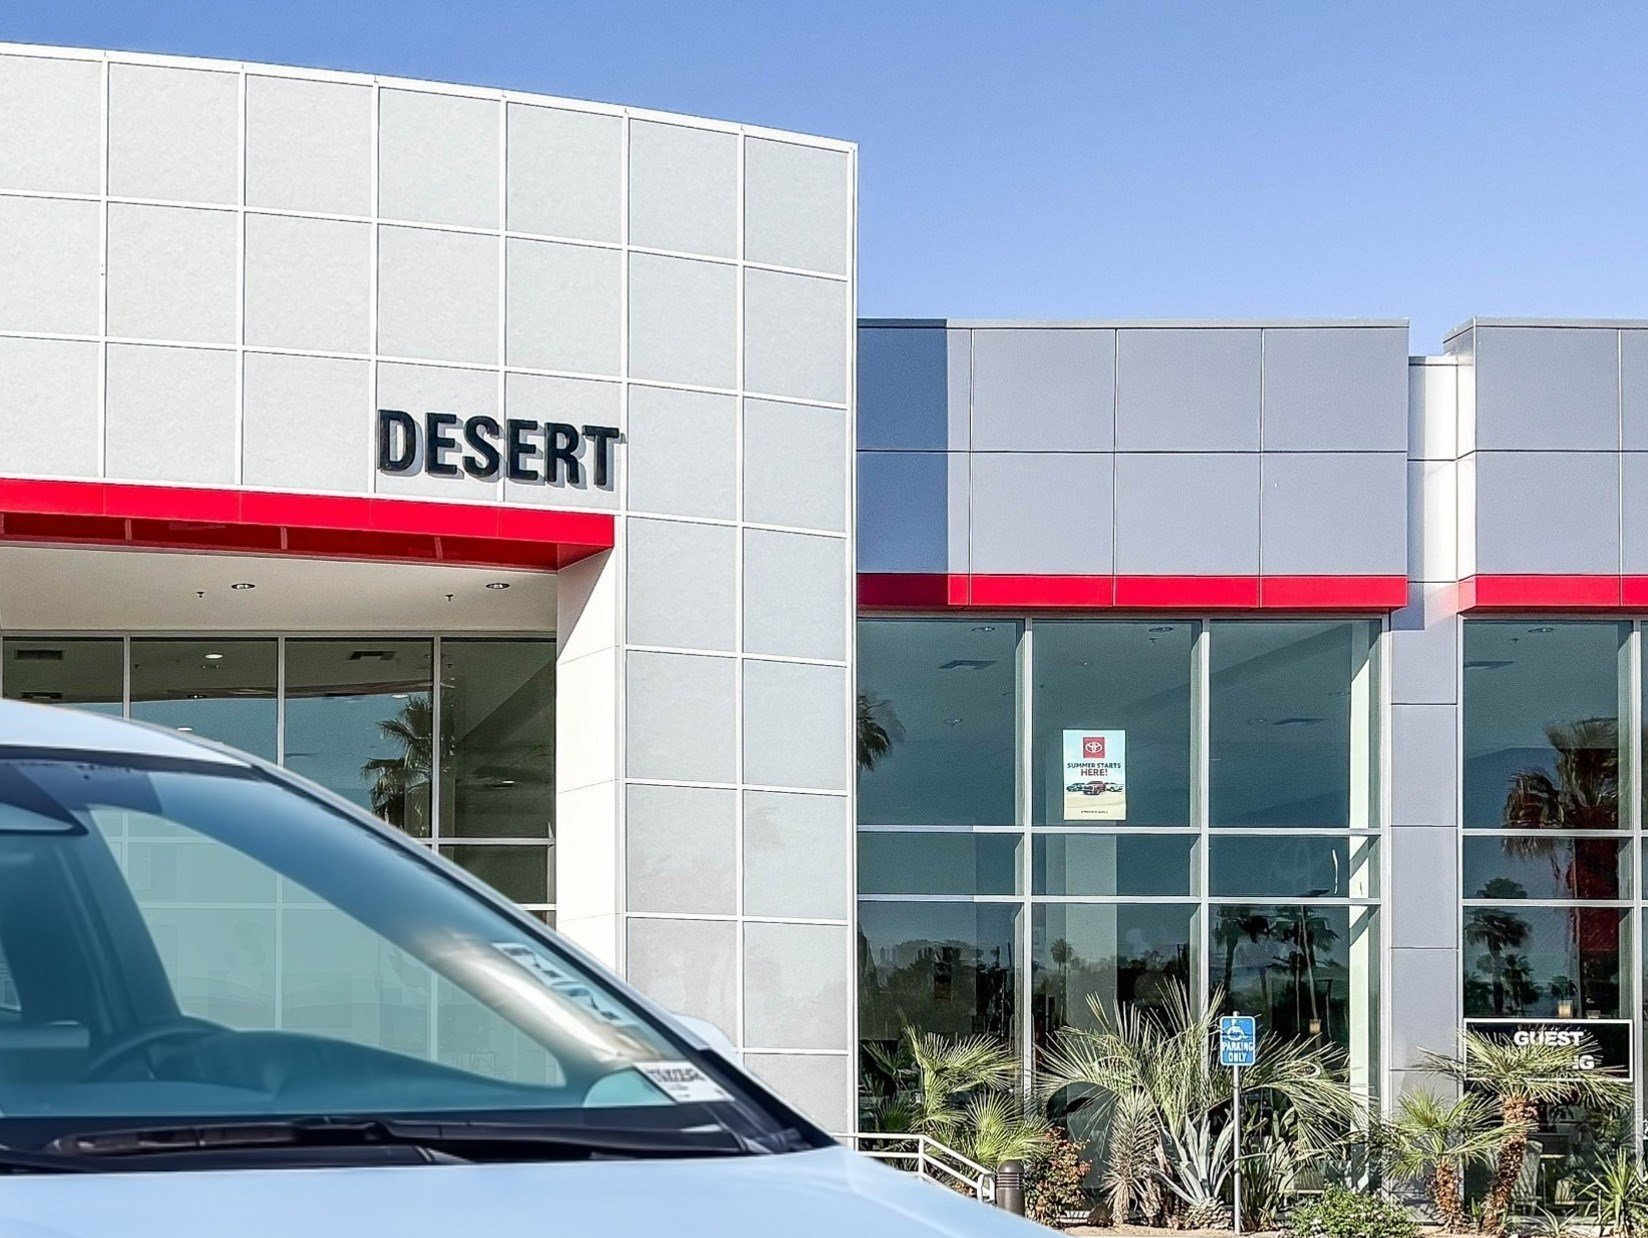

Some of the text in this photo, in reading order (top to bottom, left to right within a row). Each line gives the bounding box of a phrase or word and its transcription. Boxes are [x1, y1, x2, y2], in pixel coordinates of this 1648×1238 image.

[377, 409, 620, 486] DESERT
[1513, 1031, 1584, 1046] GUEST
[1222, 1042, 1253, 1051] PARKING
[1228, 1052, 1247, 1062] ONLY
